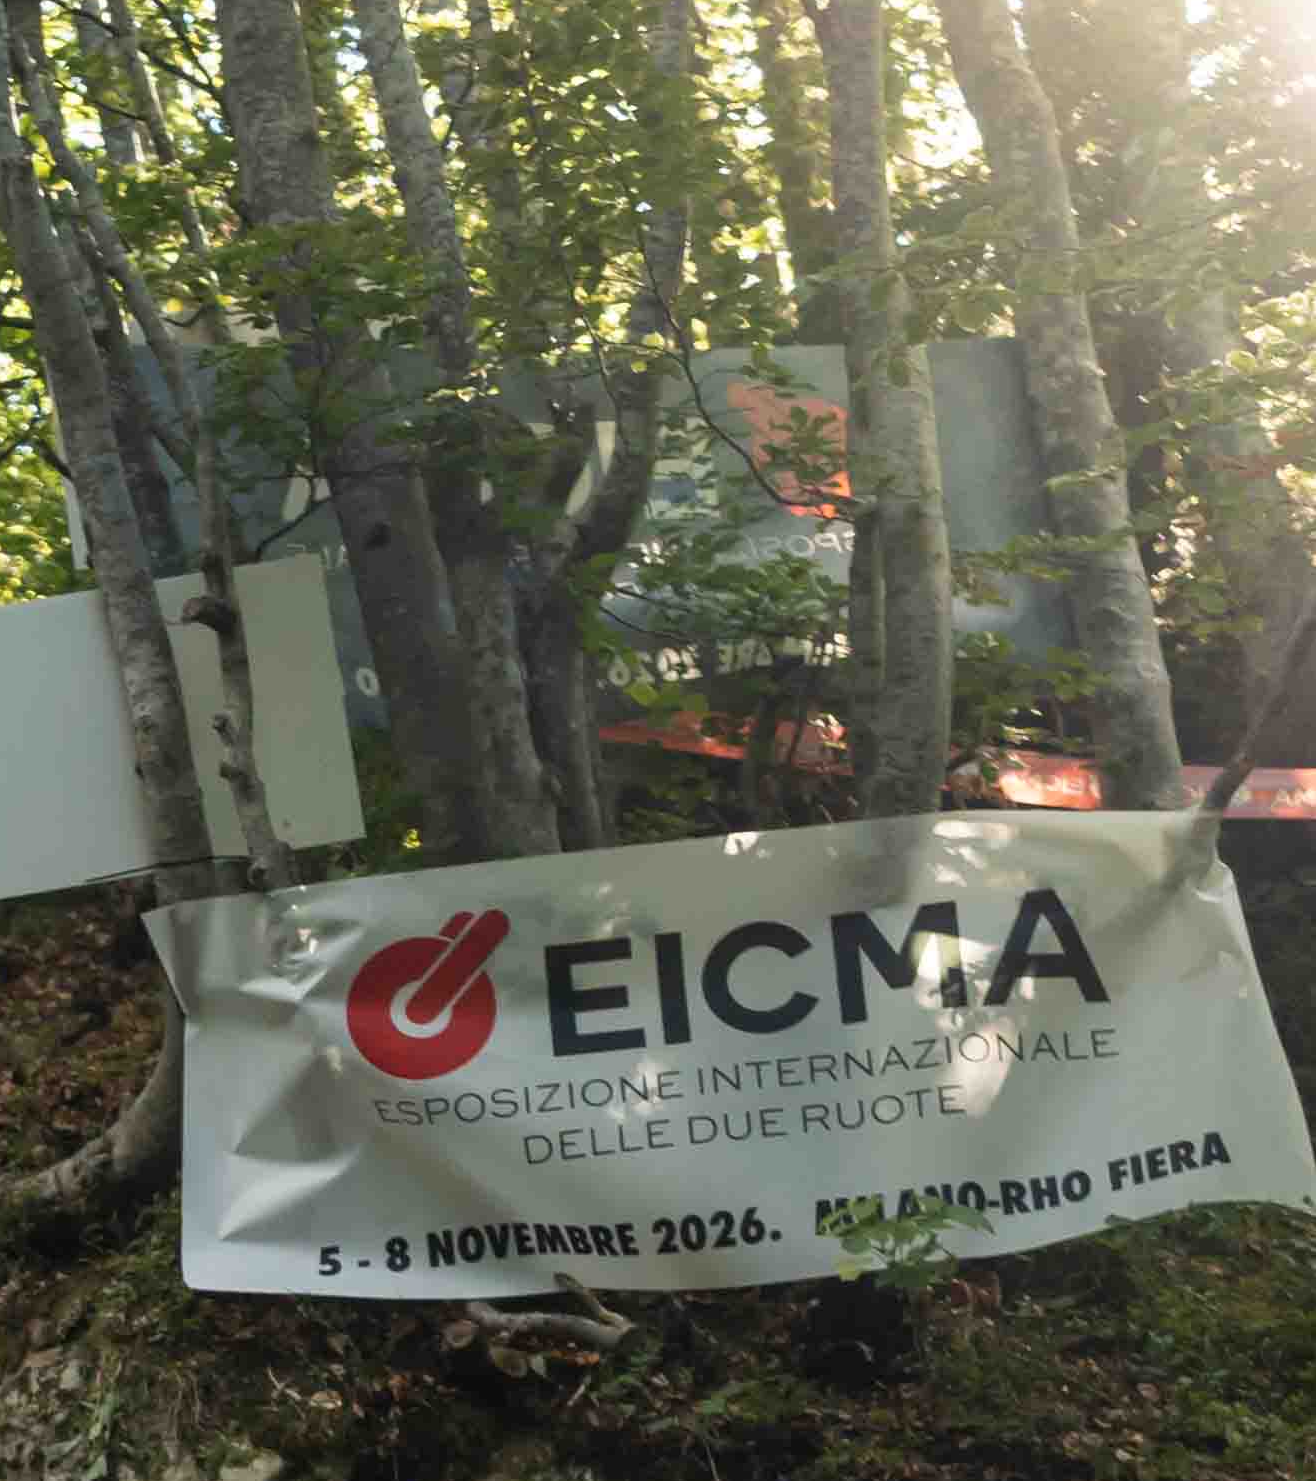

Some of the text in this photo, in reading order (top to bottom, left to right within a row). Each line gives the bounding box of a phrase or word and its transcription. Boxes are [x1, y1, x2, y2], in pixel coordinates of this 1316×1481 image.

[544, 887, 1111, 1058] EICMA
[371, 1027, 1121, 1126] ESPOSIZIONE INTERNAZIONALE
[523, 1083, 967, 1166] DELLE DUE RUOTE
[317, 1246, 343, 1277] 5
[384, 1235, 412, 1273] 8
[425, 1221, 641, 1269] NOVEMBRE
[650, 1206, 783, 1257] 2026.
[814, 1170, 1092, 1236] MLANO-RHO
[1106, 1130, 1233, 1192] FIERA
